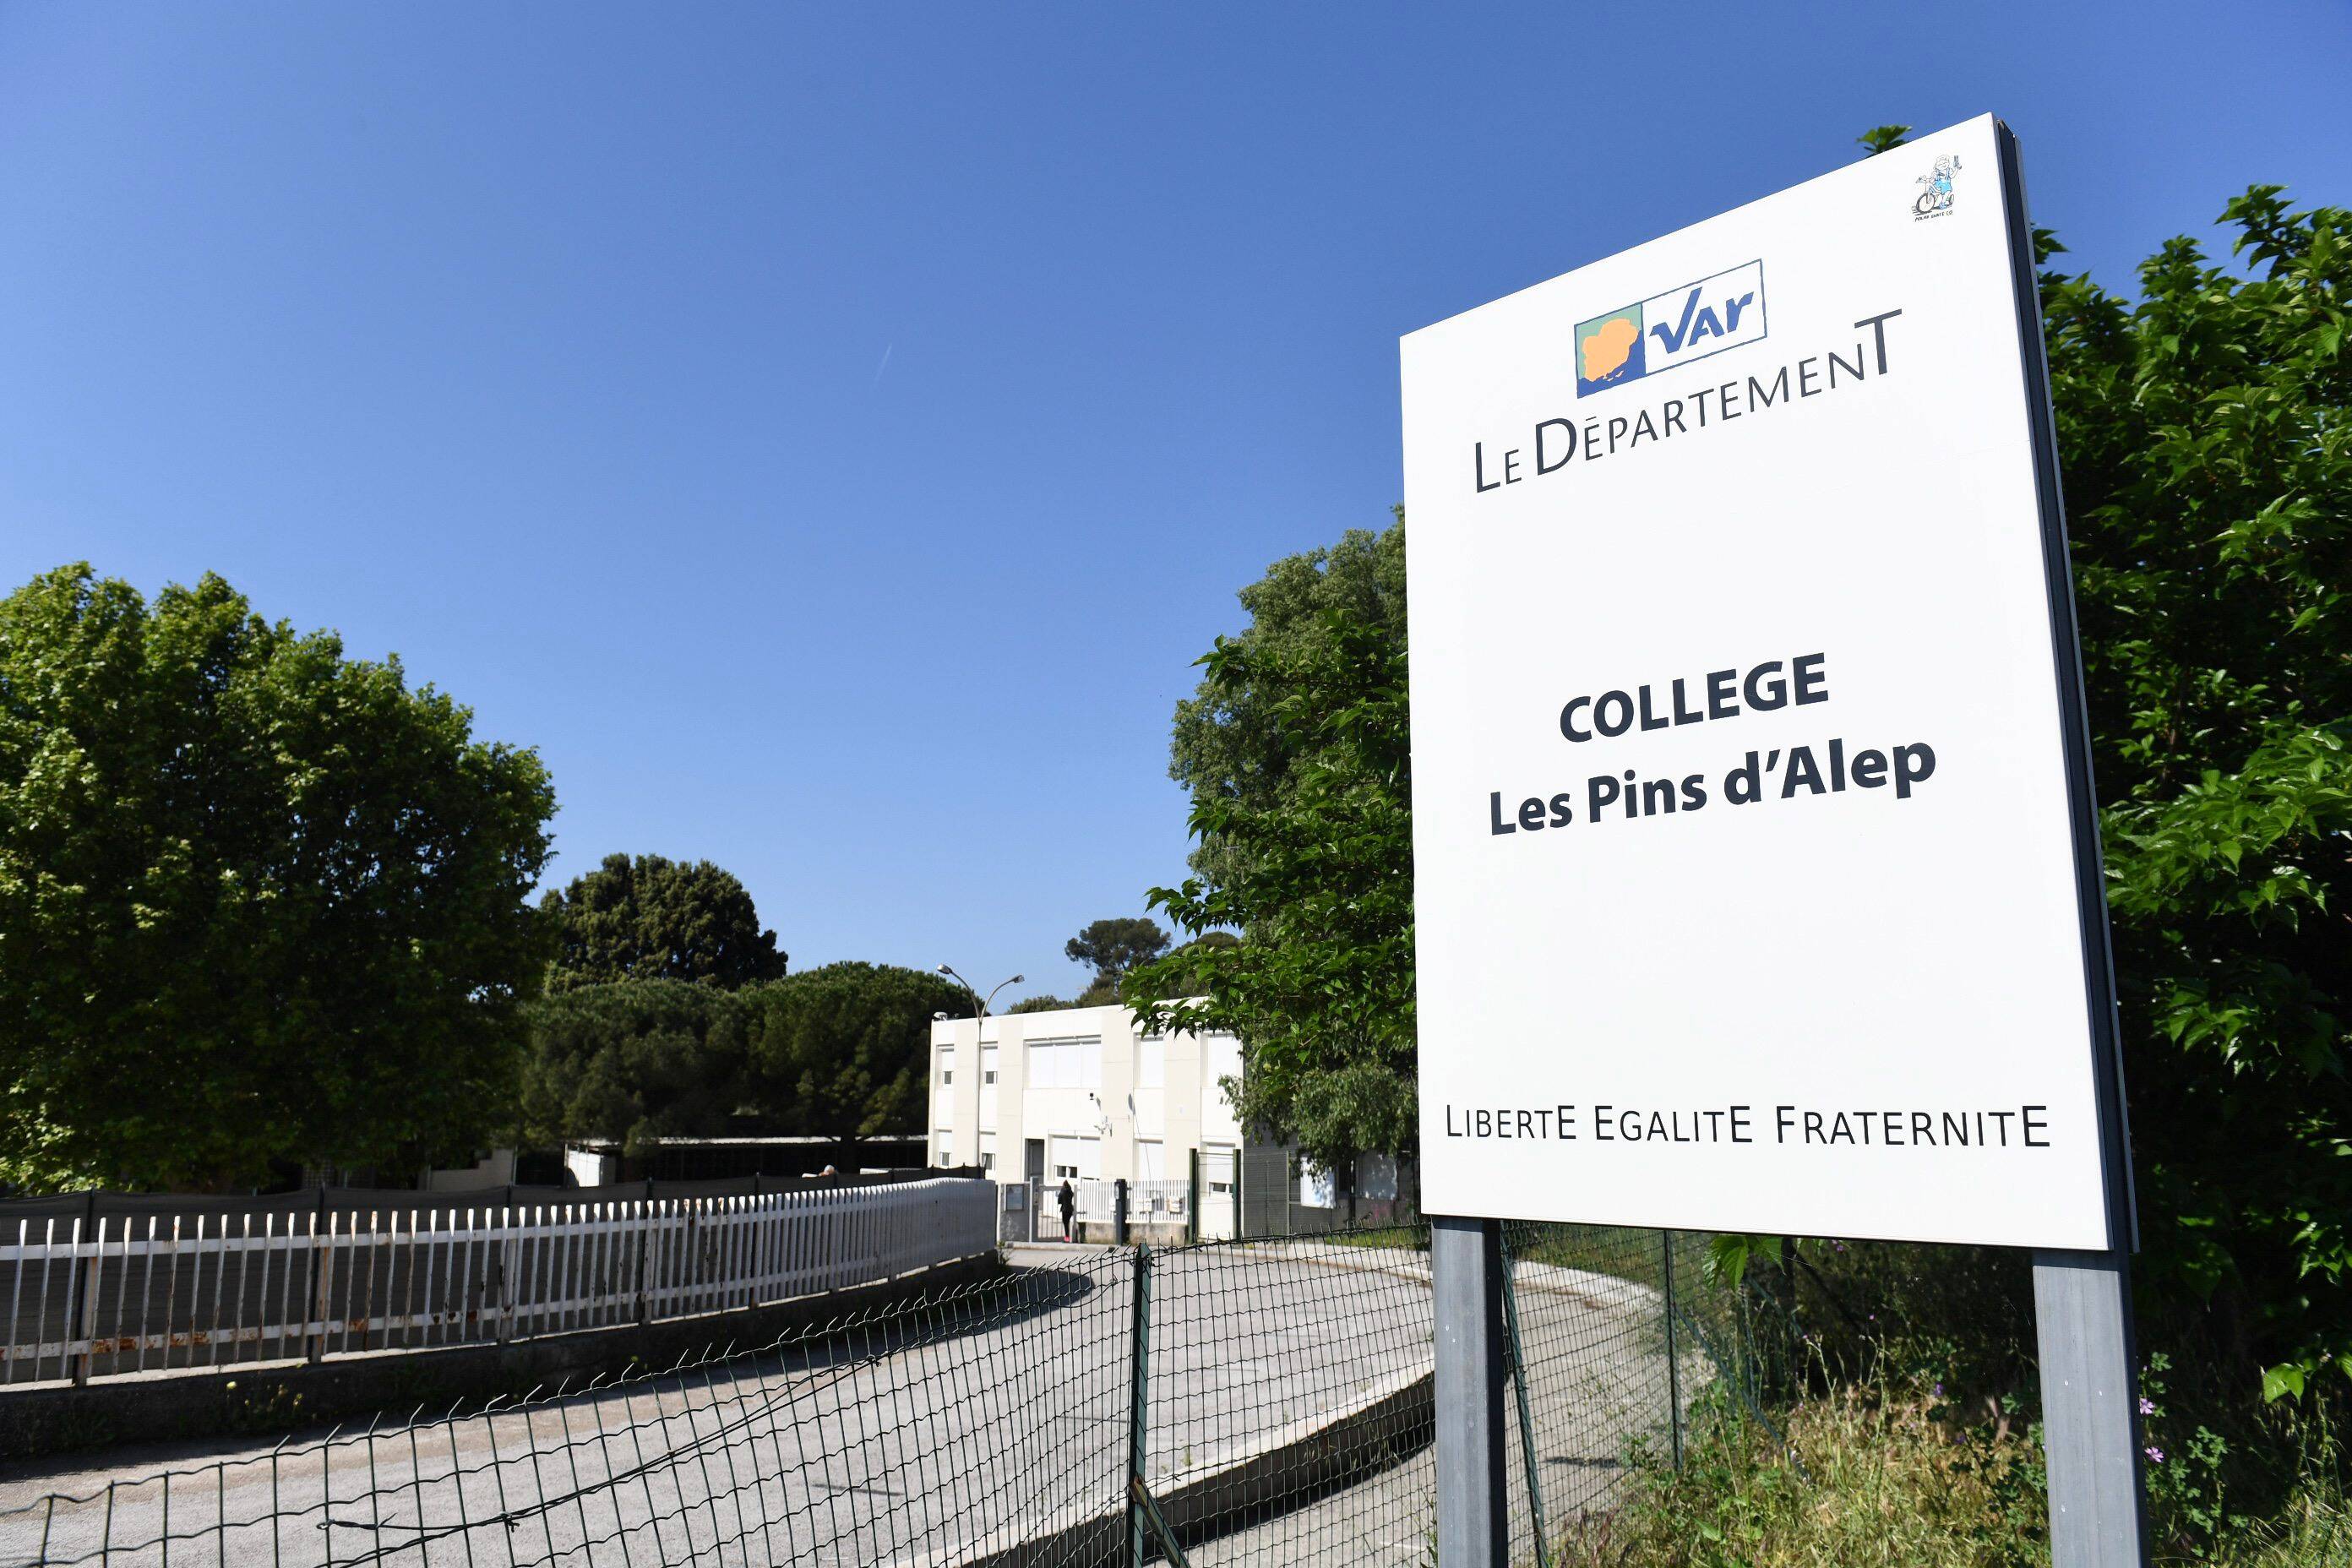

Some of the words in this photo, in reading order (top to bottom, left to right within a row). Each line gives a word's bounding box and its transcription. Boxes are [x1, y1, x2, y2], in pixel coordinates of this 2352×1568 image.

[1475, 441, 1522, 493] LE
[1560, 652, 1829, 743] COLLEGE
[1490, 791, 1573, 836] Les
[1587, 769, 1707, 824] Pins
[1446, 1104, 1576, 1140] LIBERTE
[1594, 1105, 1753, 1143] EGALITE
[1776, 1105, 2050, 1147] FRATERNITE
